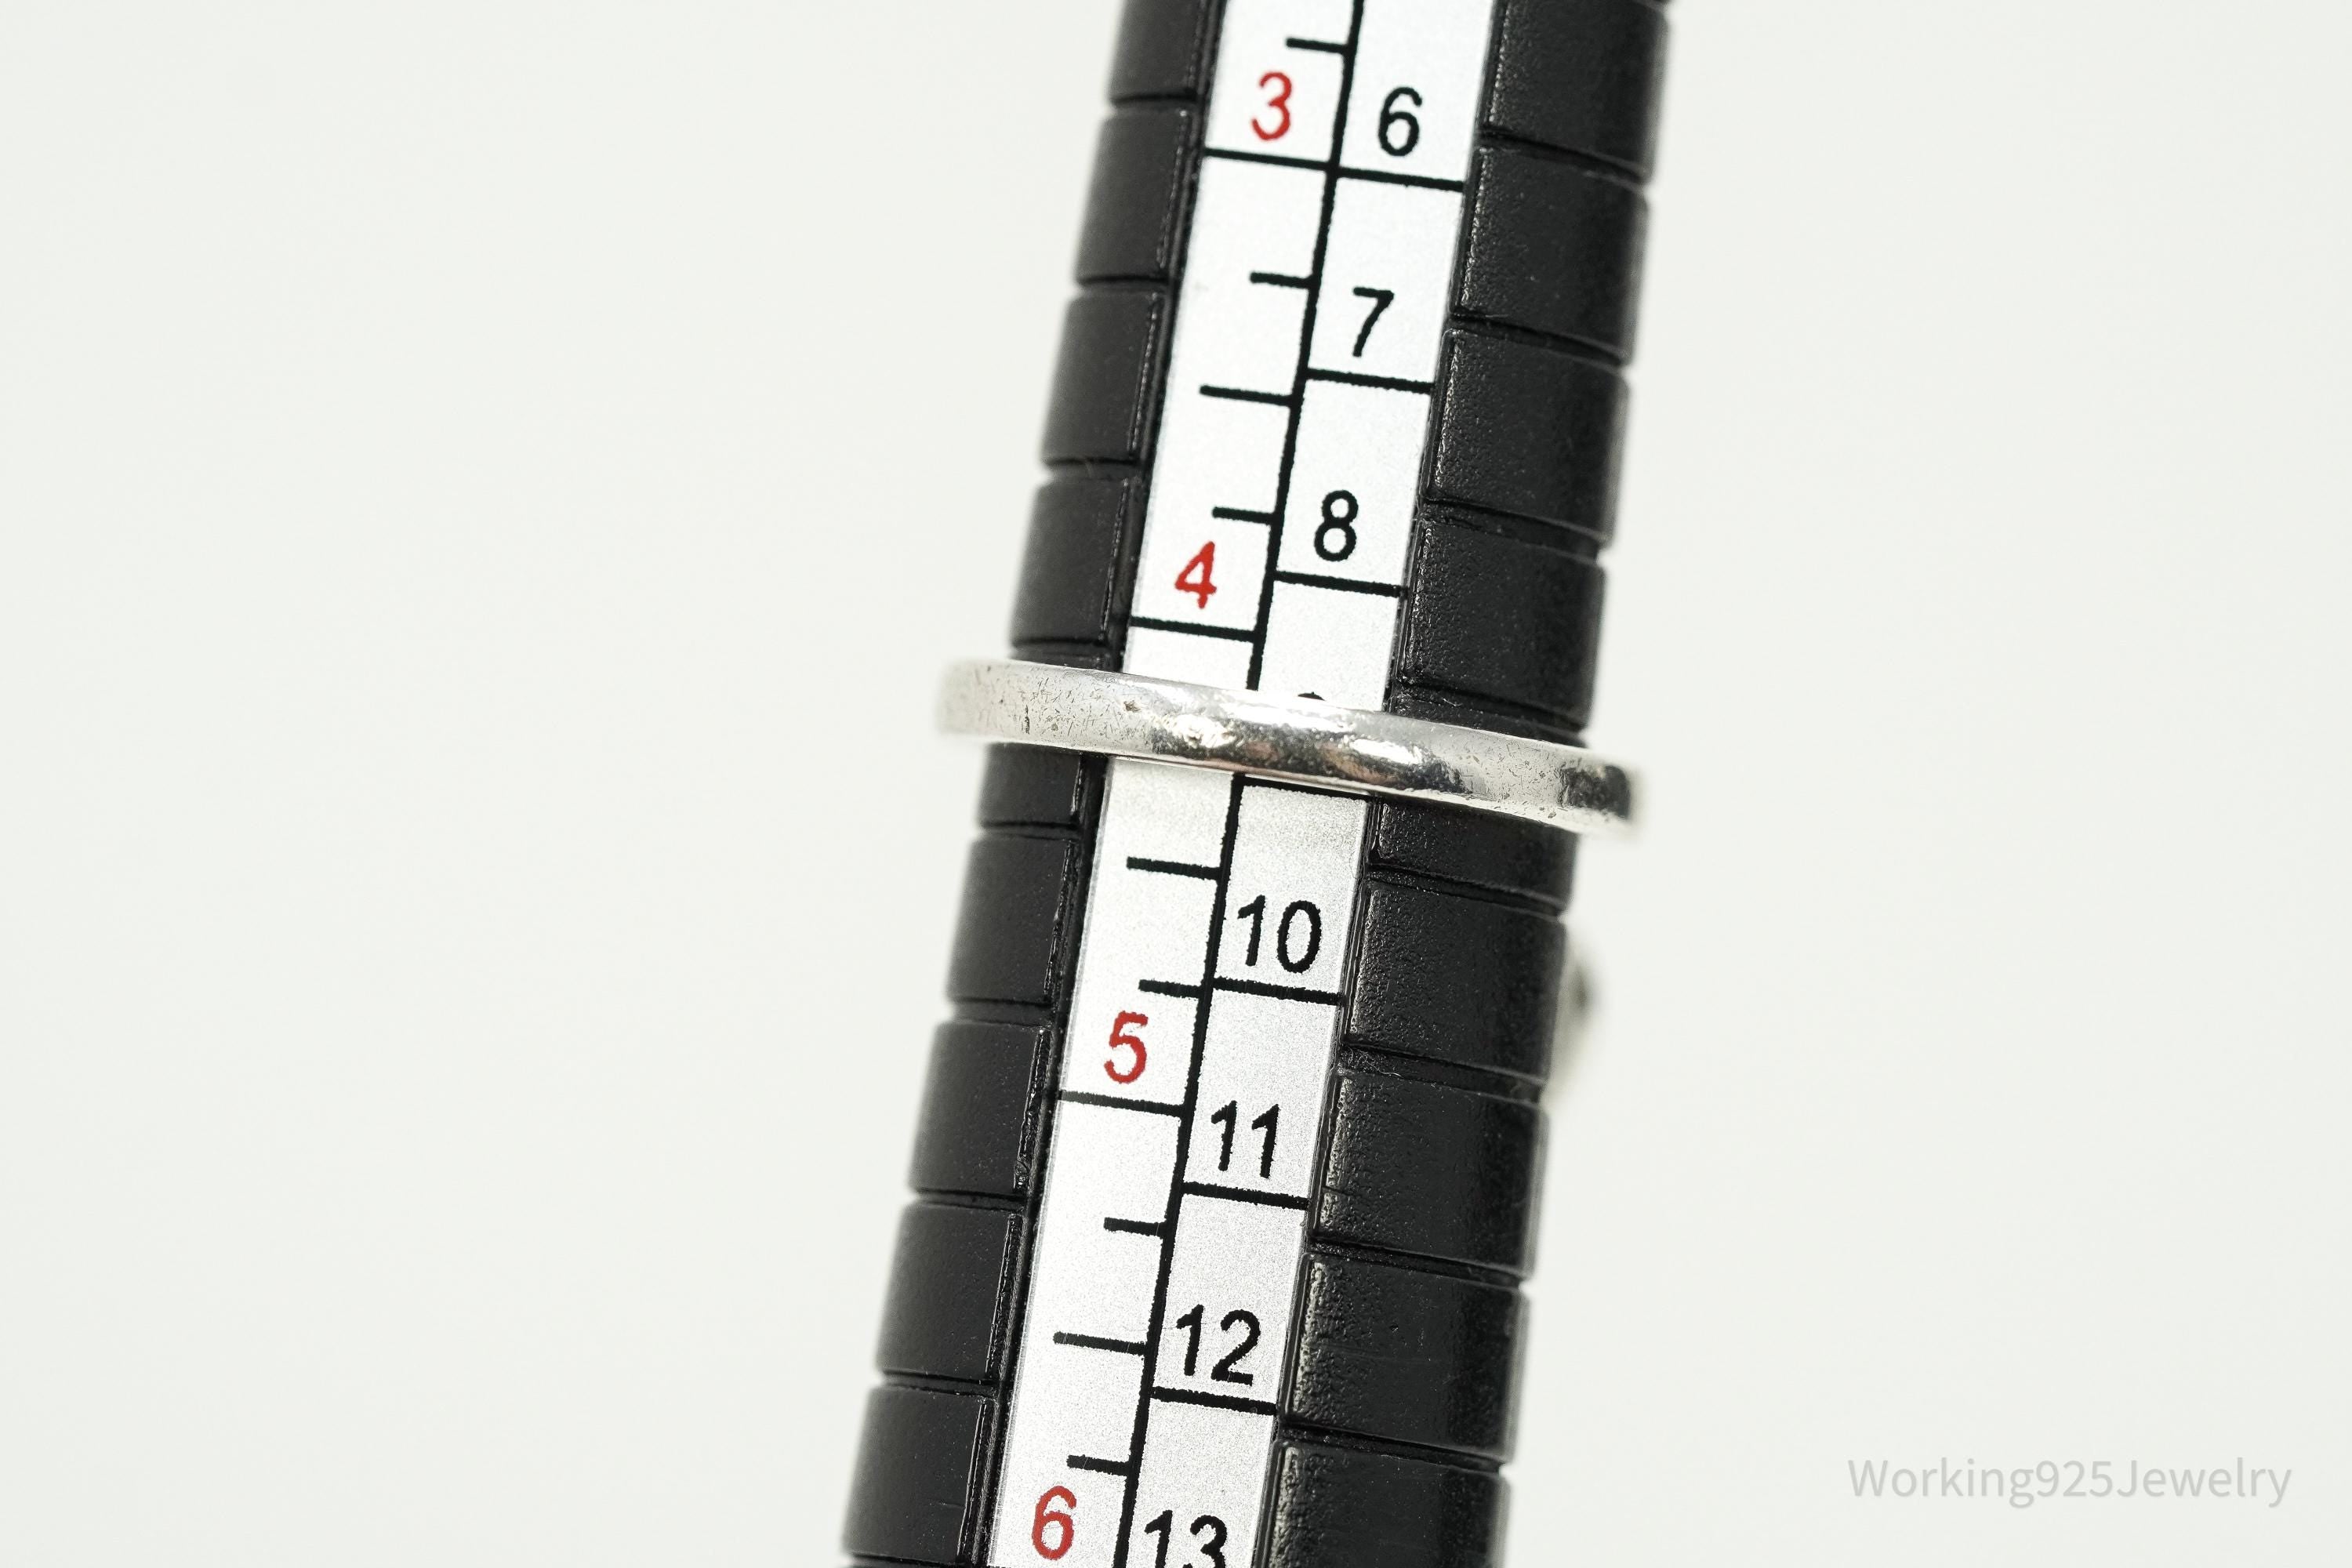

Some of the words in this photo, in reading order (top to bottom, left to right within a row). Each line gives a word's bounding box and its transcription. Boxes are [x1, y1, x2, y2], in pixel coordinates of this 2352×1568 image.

[1250, 71, 1293, 142] 3
[1377, 85, 1424, 158] 6
[1352, 285, 1396, 358] 7
[1312, 488, 1360, 563] 8
[1174, 540, 1218, 610] 4
[1236, 893, 1323, 975] 10
[1103, 1009, 1149, 1085] 5
[1210, 1099, 1282, 1181] 11
[1174, 1302, 1262, 1385] 12
[1030, 1484, 1078, 1562] 6
[1143, 1508, 1229, 1568] 13
